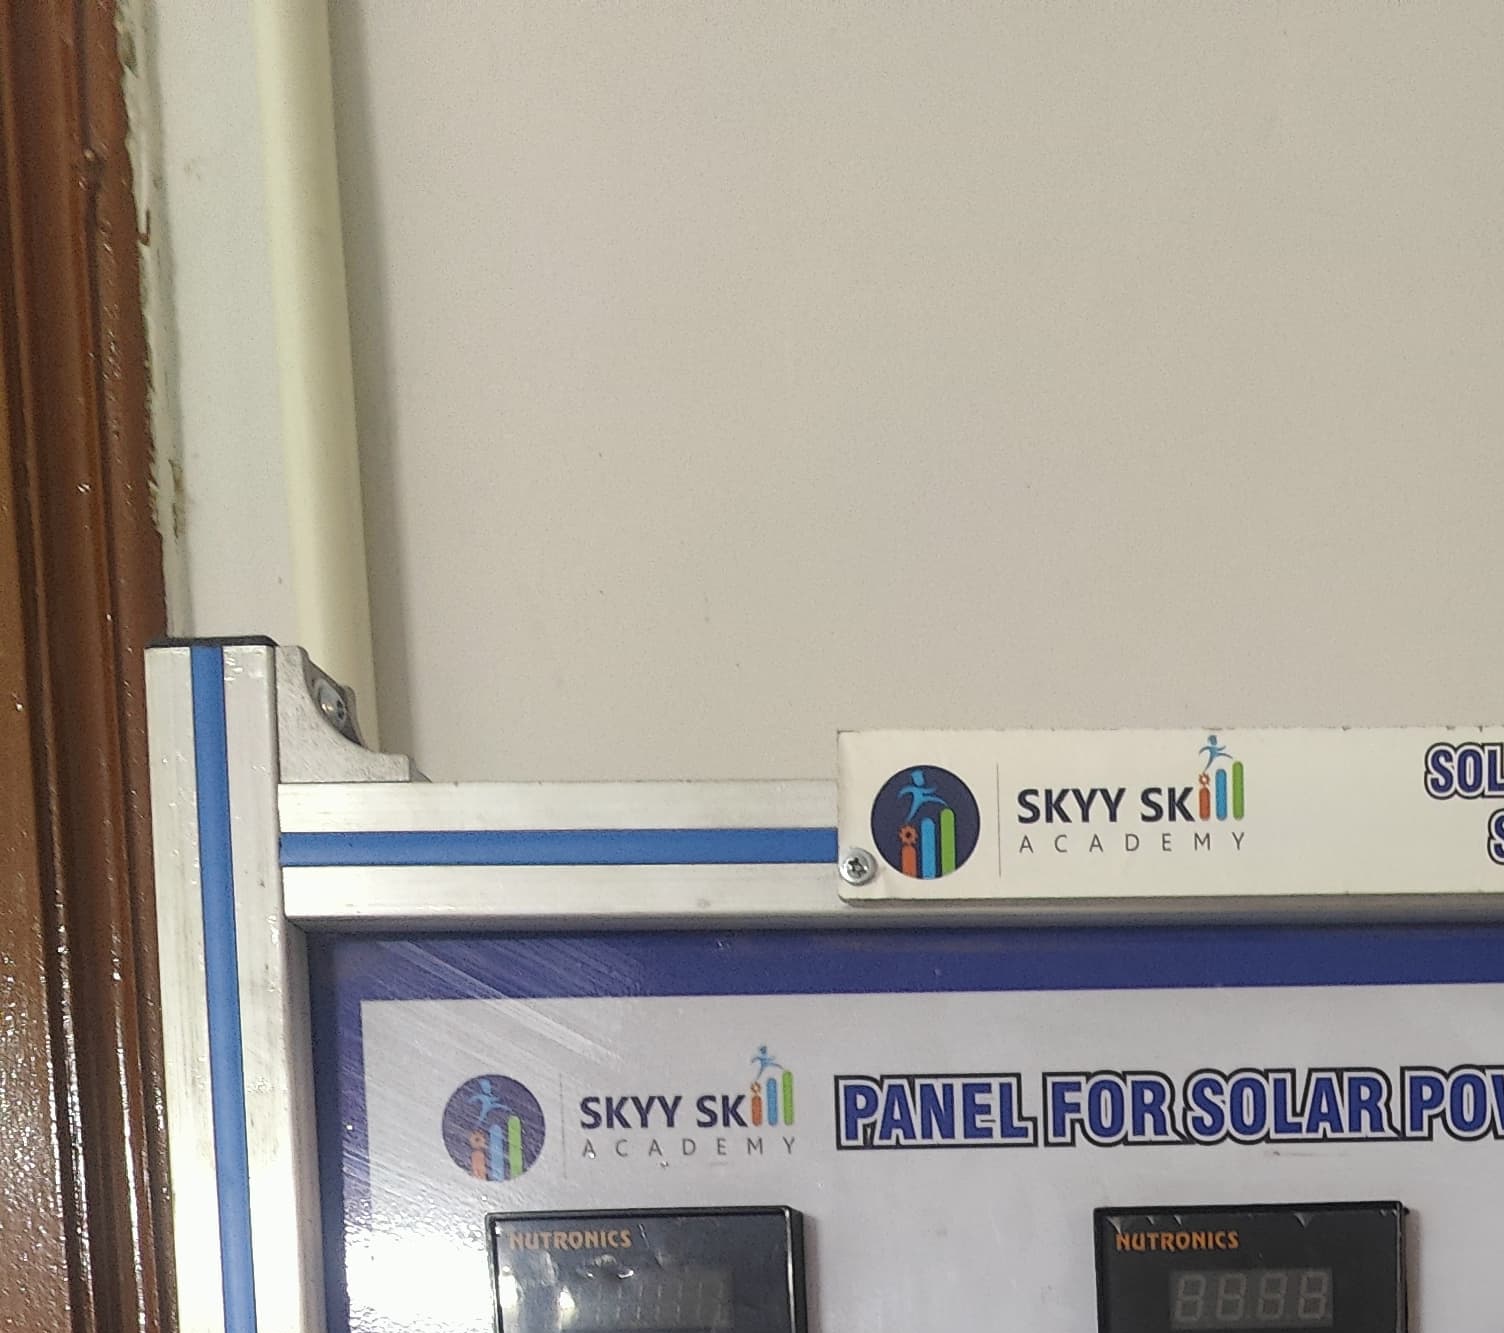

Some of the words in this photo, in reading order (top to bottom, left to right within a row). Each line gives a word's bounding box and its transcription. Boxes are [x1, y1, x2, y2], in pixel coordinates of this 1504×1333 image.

[1017, 787, 1126, 823] SKYY
[1019, 833, 1246, 853] ACADEMY
[580, 1095, 683, 1130] SKYY
[835, 1073, 1038, 1149] PANEL
[1043, 1069, 1184, 1148] FOR
[1184, 1067, 1398, 1146] SOLAR
[582, 1136, 795, 1158] ACADEMY
[509, 1228, 633, 1250] NUTRONICS
[1115, 1231, 1240, 1252] NUTRONICS
